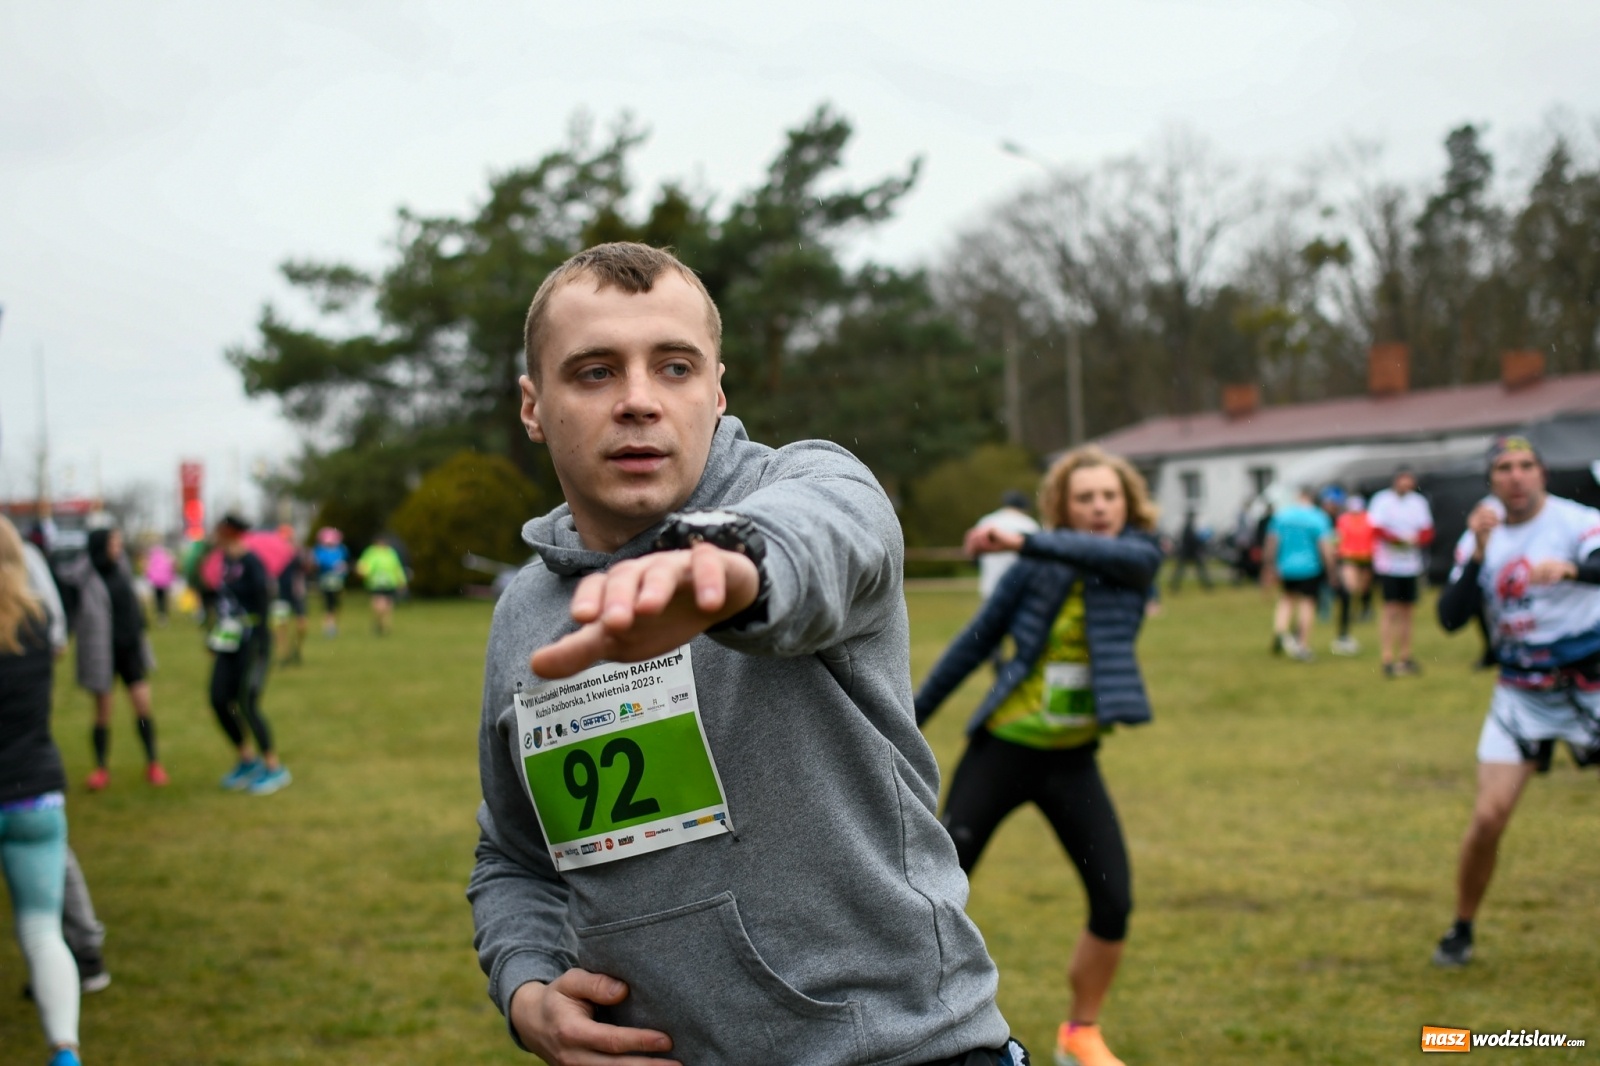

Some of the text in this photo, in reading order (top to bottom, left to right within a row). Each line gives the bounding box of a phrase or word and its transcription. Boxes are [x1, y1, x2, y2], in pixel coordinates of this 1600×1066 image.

[559, 677, 602, 696] Półmaraton
[602, 670, 629, 683] Leśny
[630, 655, 681, 676] RAFAMET
[535, 675, 664, 719] Kuźnia Raciborska, 1 kwietnia 2023 r.
[583, 712, 612, 727] RAFAMET
[563, 737, 661, 832] 92
